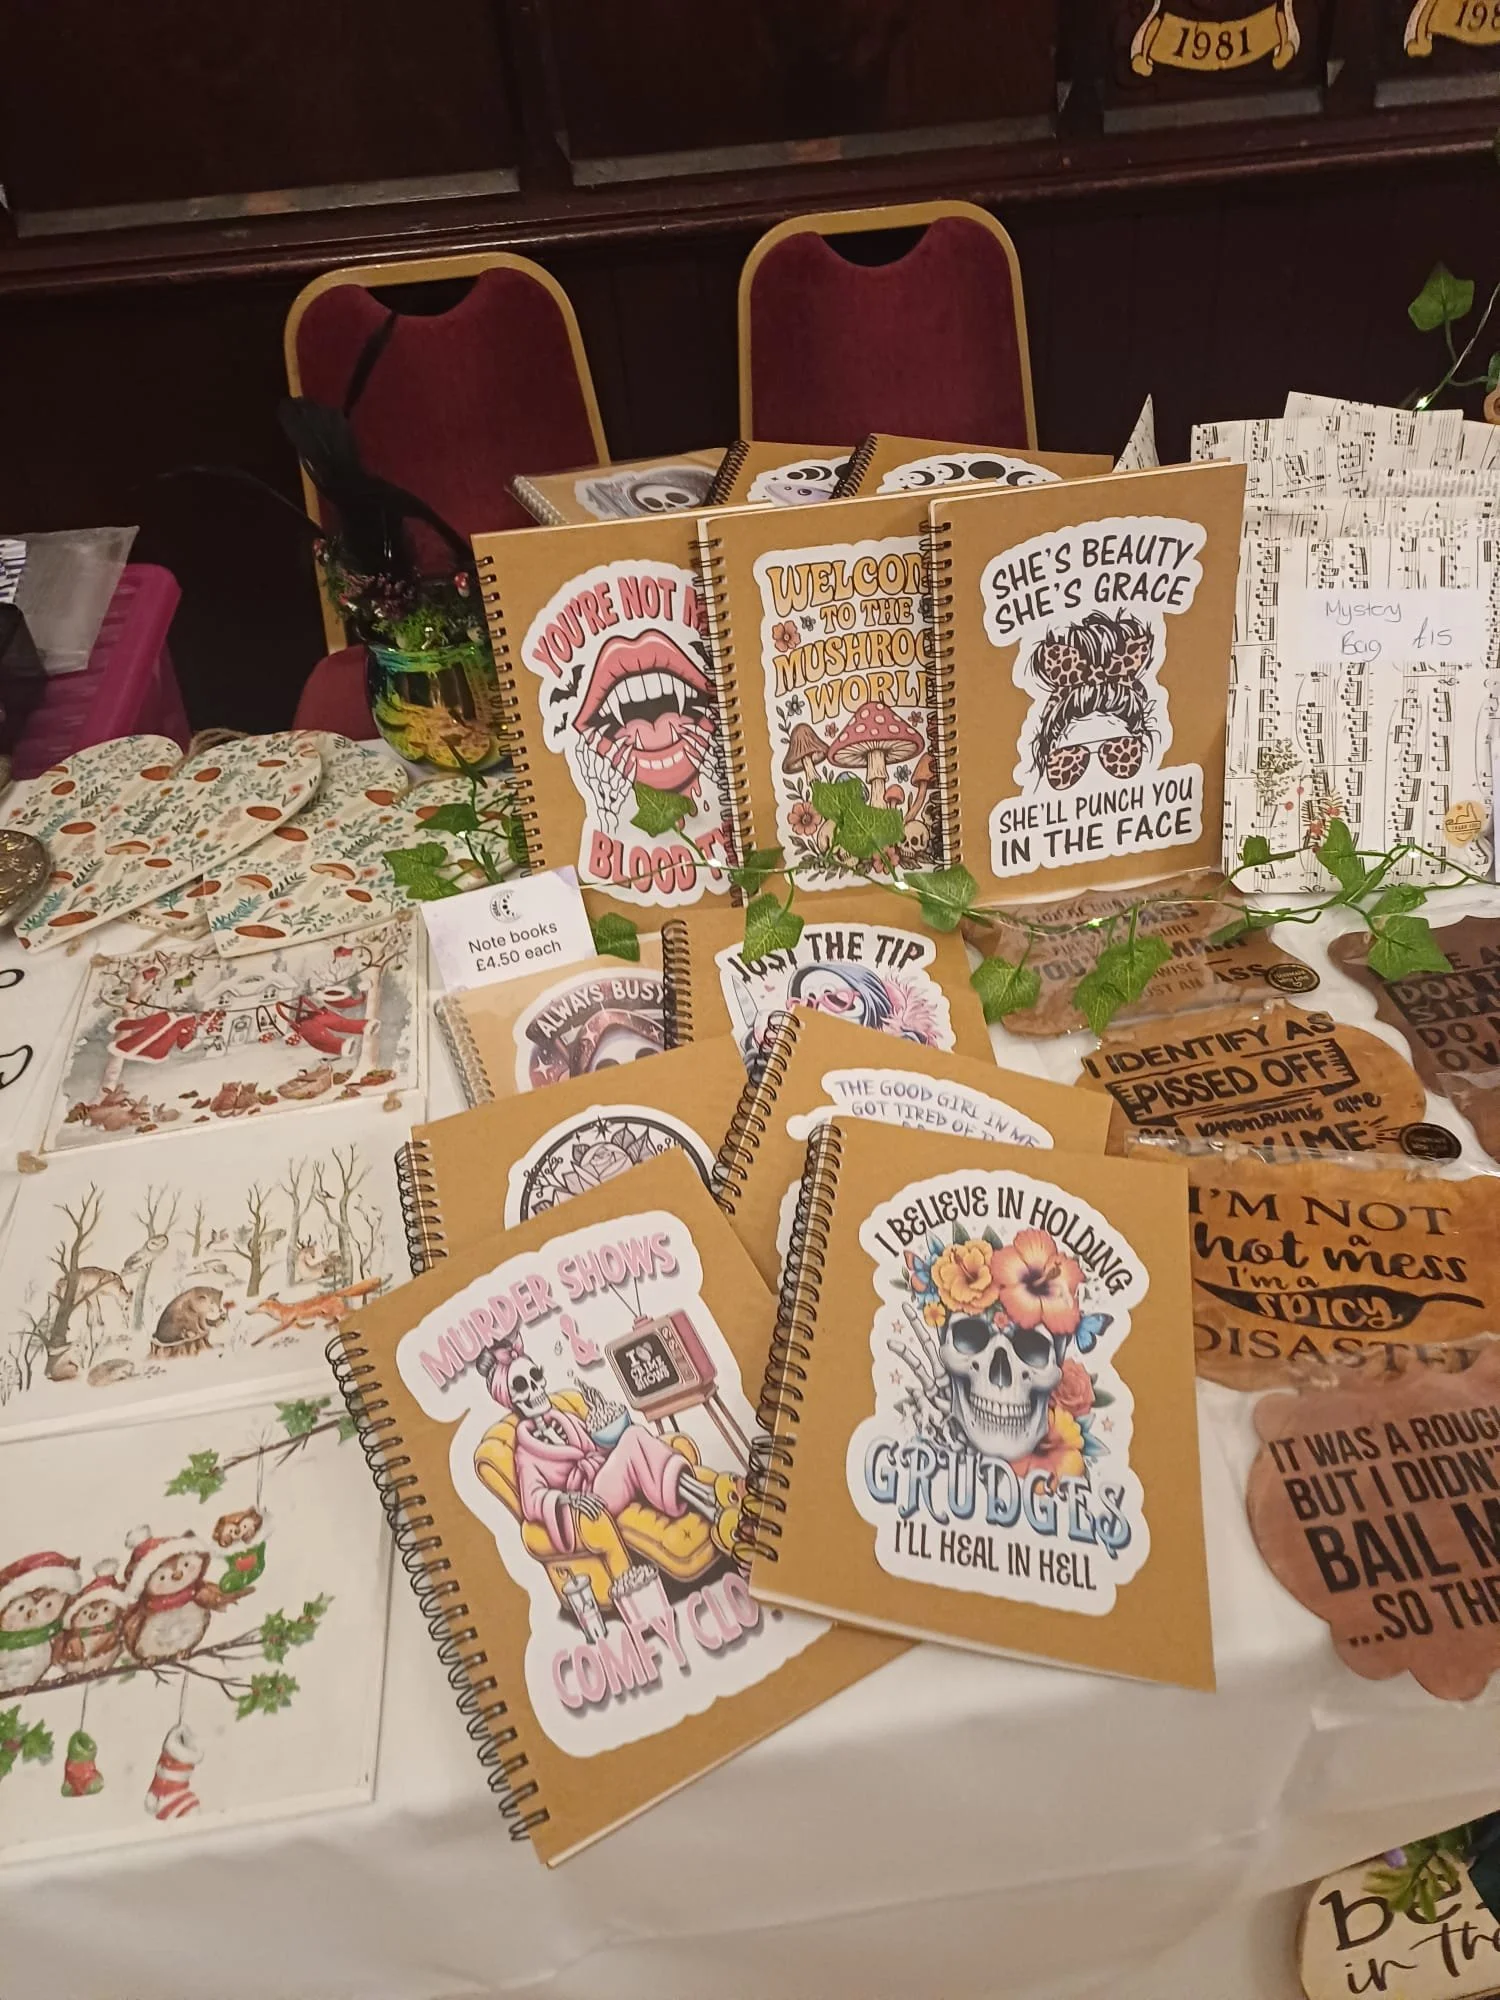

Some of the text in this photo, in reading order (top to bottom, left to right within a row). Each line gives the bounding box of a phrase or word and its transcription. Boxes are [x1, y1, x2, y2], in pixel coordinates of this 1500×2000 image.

[1172, 26, 1253, 61] 1981
[992, 534, 1194, 601] SHE'S BEAUTY
[532, 582, 620, 679] YOU'RE
[617, 576, 677, 621] NOT
[820, 597, 914, 634] TO THE
[995, 572, 1191, 635] SHE'S GRACE
[1341, 616, 1453, 662] Bag £15
[999, 776, 1193, 834] SHE'LL PUNCH YOU
[588, 830, 697, 894] BLOOD
[1000, 807, 1193, 867] IN THE FACE
[468, 920, 558, 954] Note books
[476, 939, 562, 973] £4.50 each
[804, 932, 865, 963] THE
[876, 934, 926, 970] TIP
[535, 984, 603, 1039] ALWAYS
[1105, 1022, 1271, 1075] IDENTIFY
[1285, 1012, 1336, 1042] AS
[835, 1080, 875, 1098] THE
[880, 1081, 933, 1101] GOOD
[937, 1092, 980, 1119] GIRL
[983, 1111, 1008, 1132] IN
[1132, 1049, 1333, 1115] PISSED OFF
[1333, 1091, 1382, 1114] are
[851, 1101, 888, 1116] GOT
[892, 1102, 948, 1127] TIRED
[1189, 1186, 1452, 1236] I'M NOT
[874, 1185, 1134, 1297] I BELIEVE IN HOLDING
[1194, 1221, 1468, 1283] hot mess
[1348, 1234, 1372, 1247] a
[1227, 1266, 1320, 1289] I'm a
[419, 1231, 681, 1392] MURDER SHOWS
[1255, 1294, 1403, 1329] spicy
[558, 1314, 604, 1369] &
[625, 1349, 641, 1367] I
[1268, 1437, 1301, 1473] IT
[1303, 1425, 1382, 1467] WAS
[1384, 1421, 1412, 1456] A
[864, 1436, 1133, 1560] GRUDGES
[1284, 1469, 1365, 1521] BUT
[1368, 1465, 1394, 1508] I
[894, 1519, 1098, 1591] I'LL HEAL IN HELL
[1304, 1511, 1461, 1594] BAIL
[552, 1608, 691, 1711] COMFY
